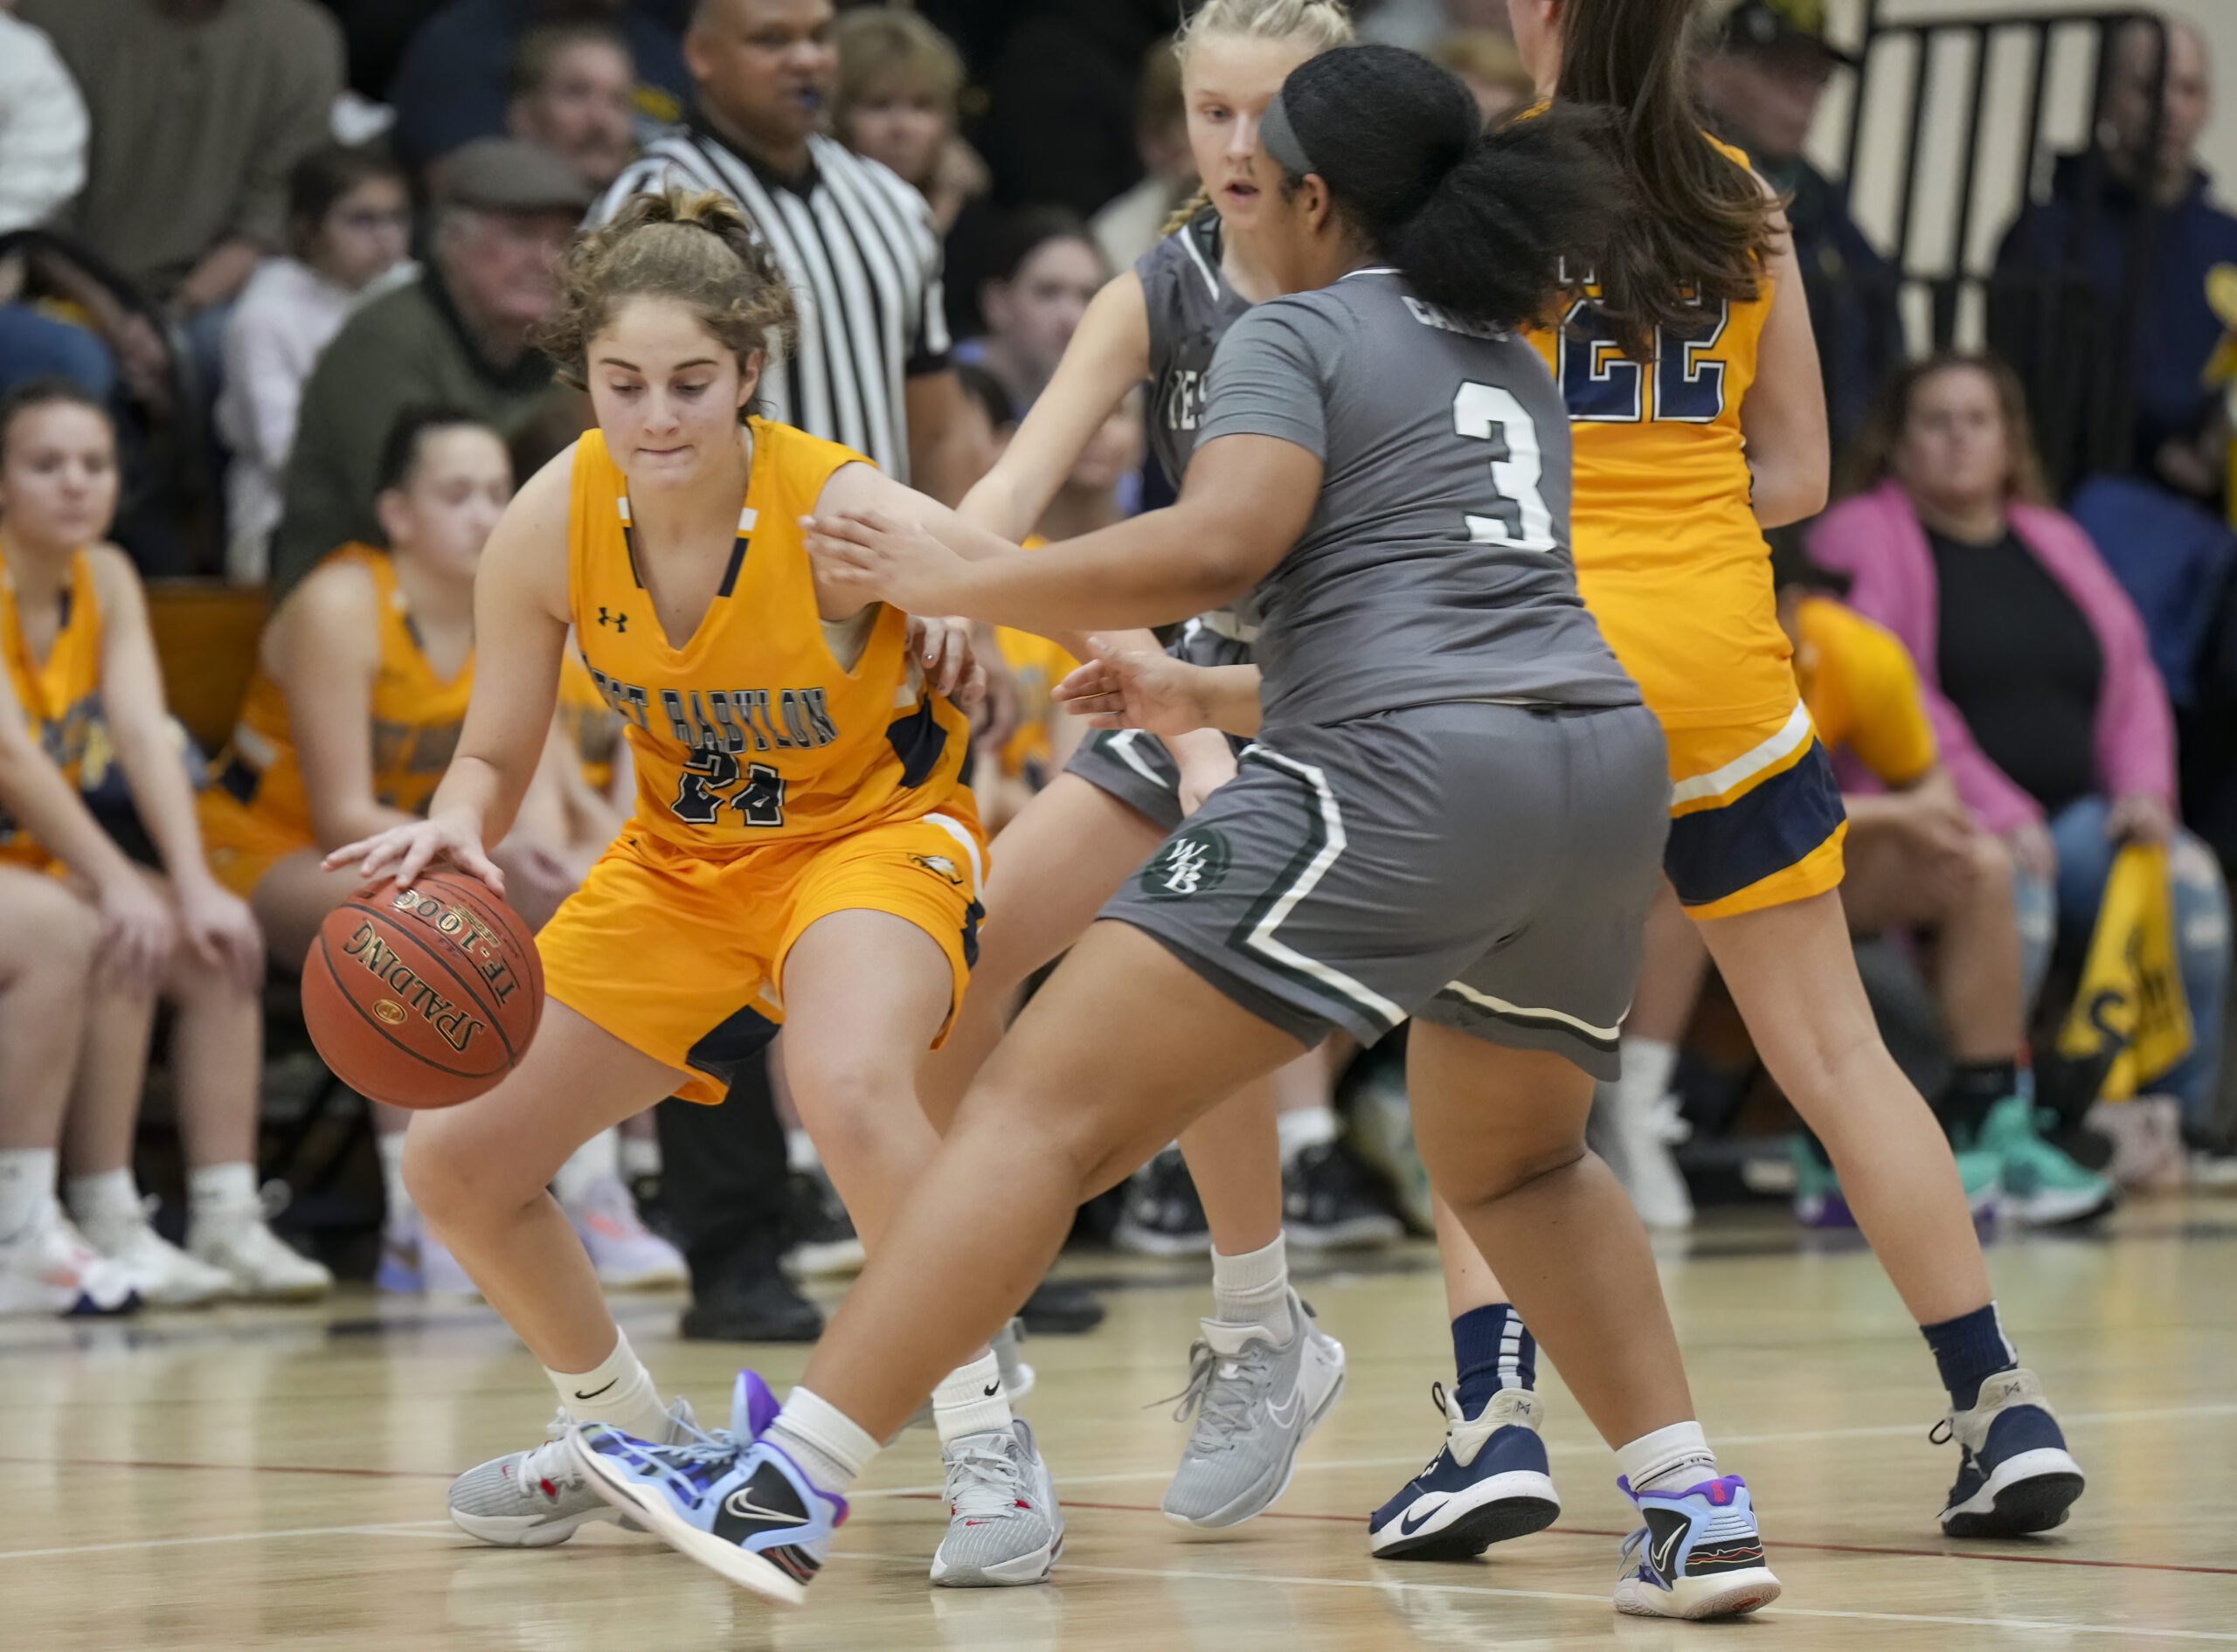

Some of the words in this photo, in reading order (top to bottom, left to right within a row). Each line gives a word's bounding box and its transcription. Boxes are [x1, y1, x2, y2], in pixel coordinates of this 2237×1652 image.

[1452, 380, 1558, 553] 3
[659, 687, 840, 753] BABYLON
[670, 745, 786, 826] 24
[342, 920, 488, 1054] SPALDING
[392, 888, 516, 1005] TF-1000
